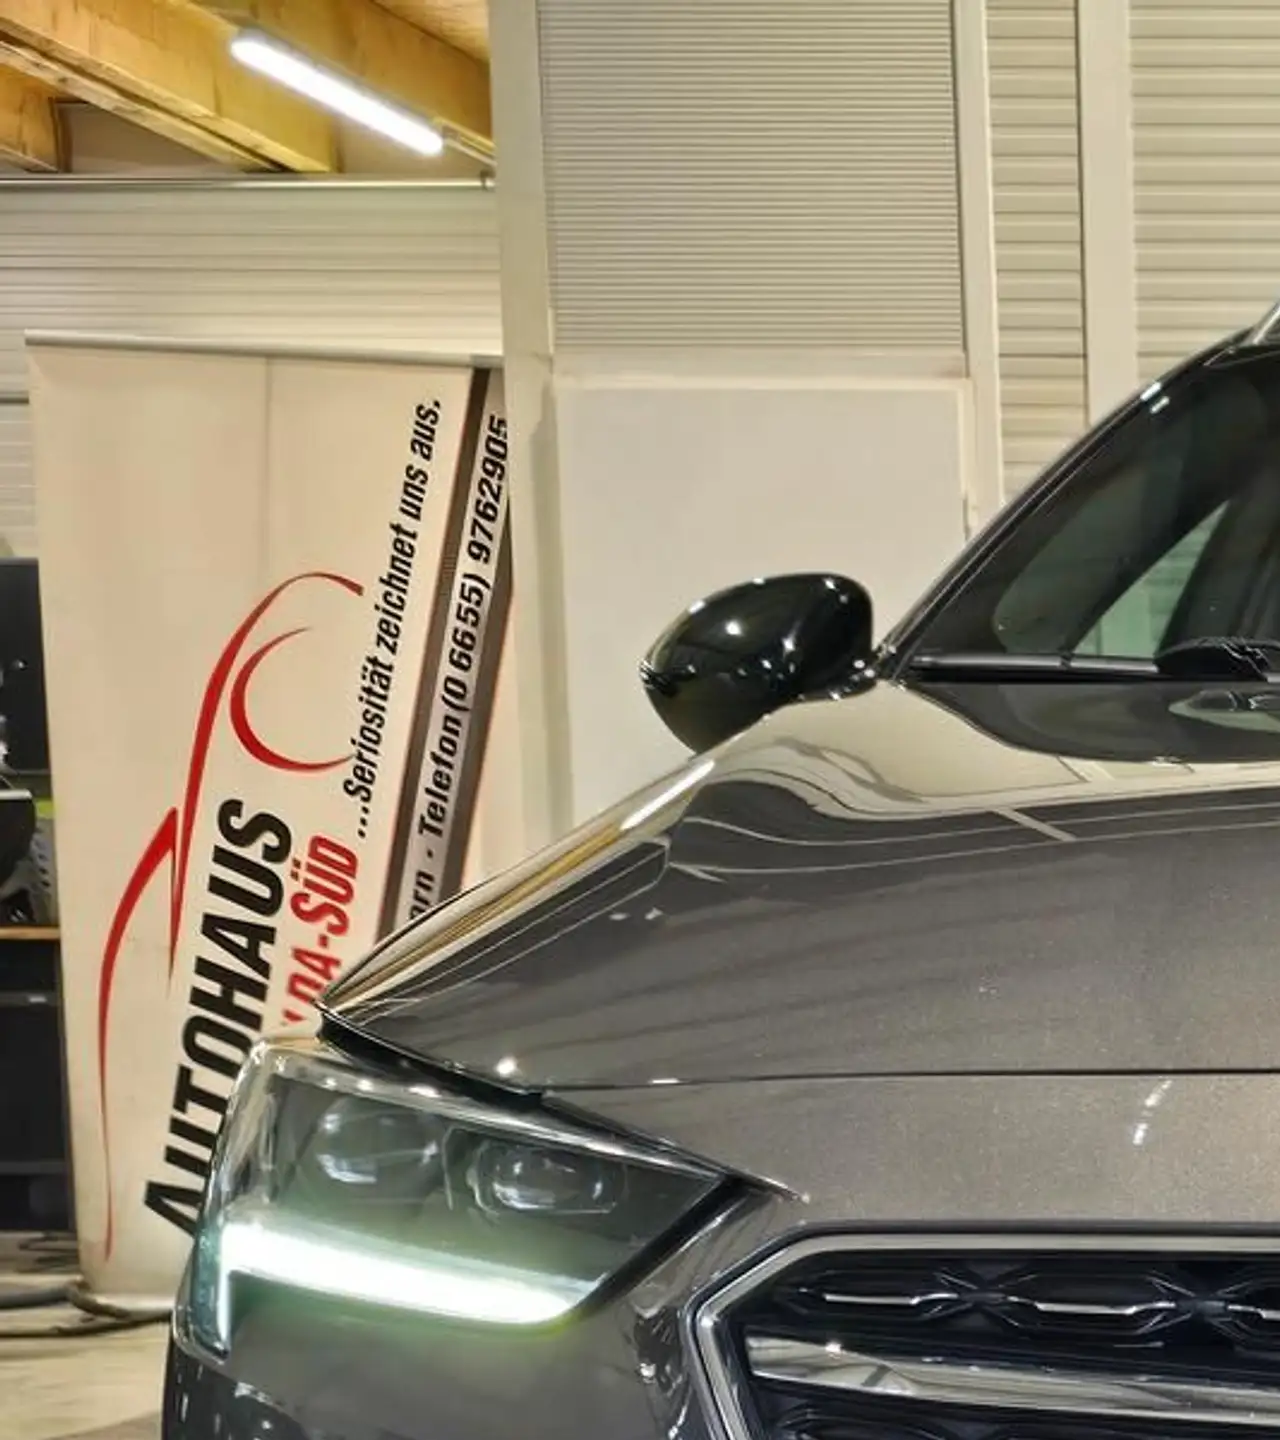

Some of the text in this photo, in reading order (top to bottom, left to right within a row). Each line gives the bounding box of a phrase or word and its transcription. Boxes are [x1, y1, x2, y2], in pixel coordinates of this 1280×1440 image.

[399, 463, 429, 522] uns
[410, 399, 441, 462] aus.
[374, 521, 418, 657] zeichnet
[417, 713, 462, 838] Telefon
[143, 798, 293, 1239] AUTOHAUS
